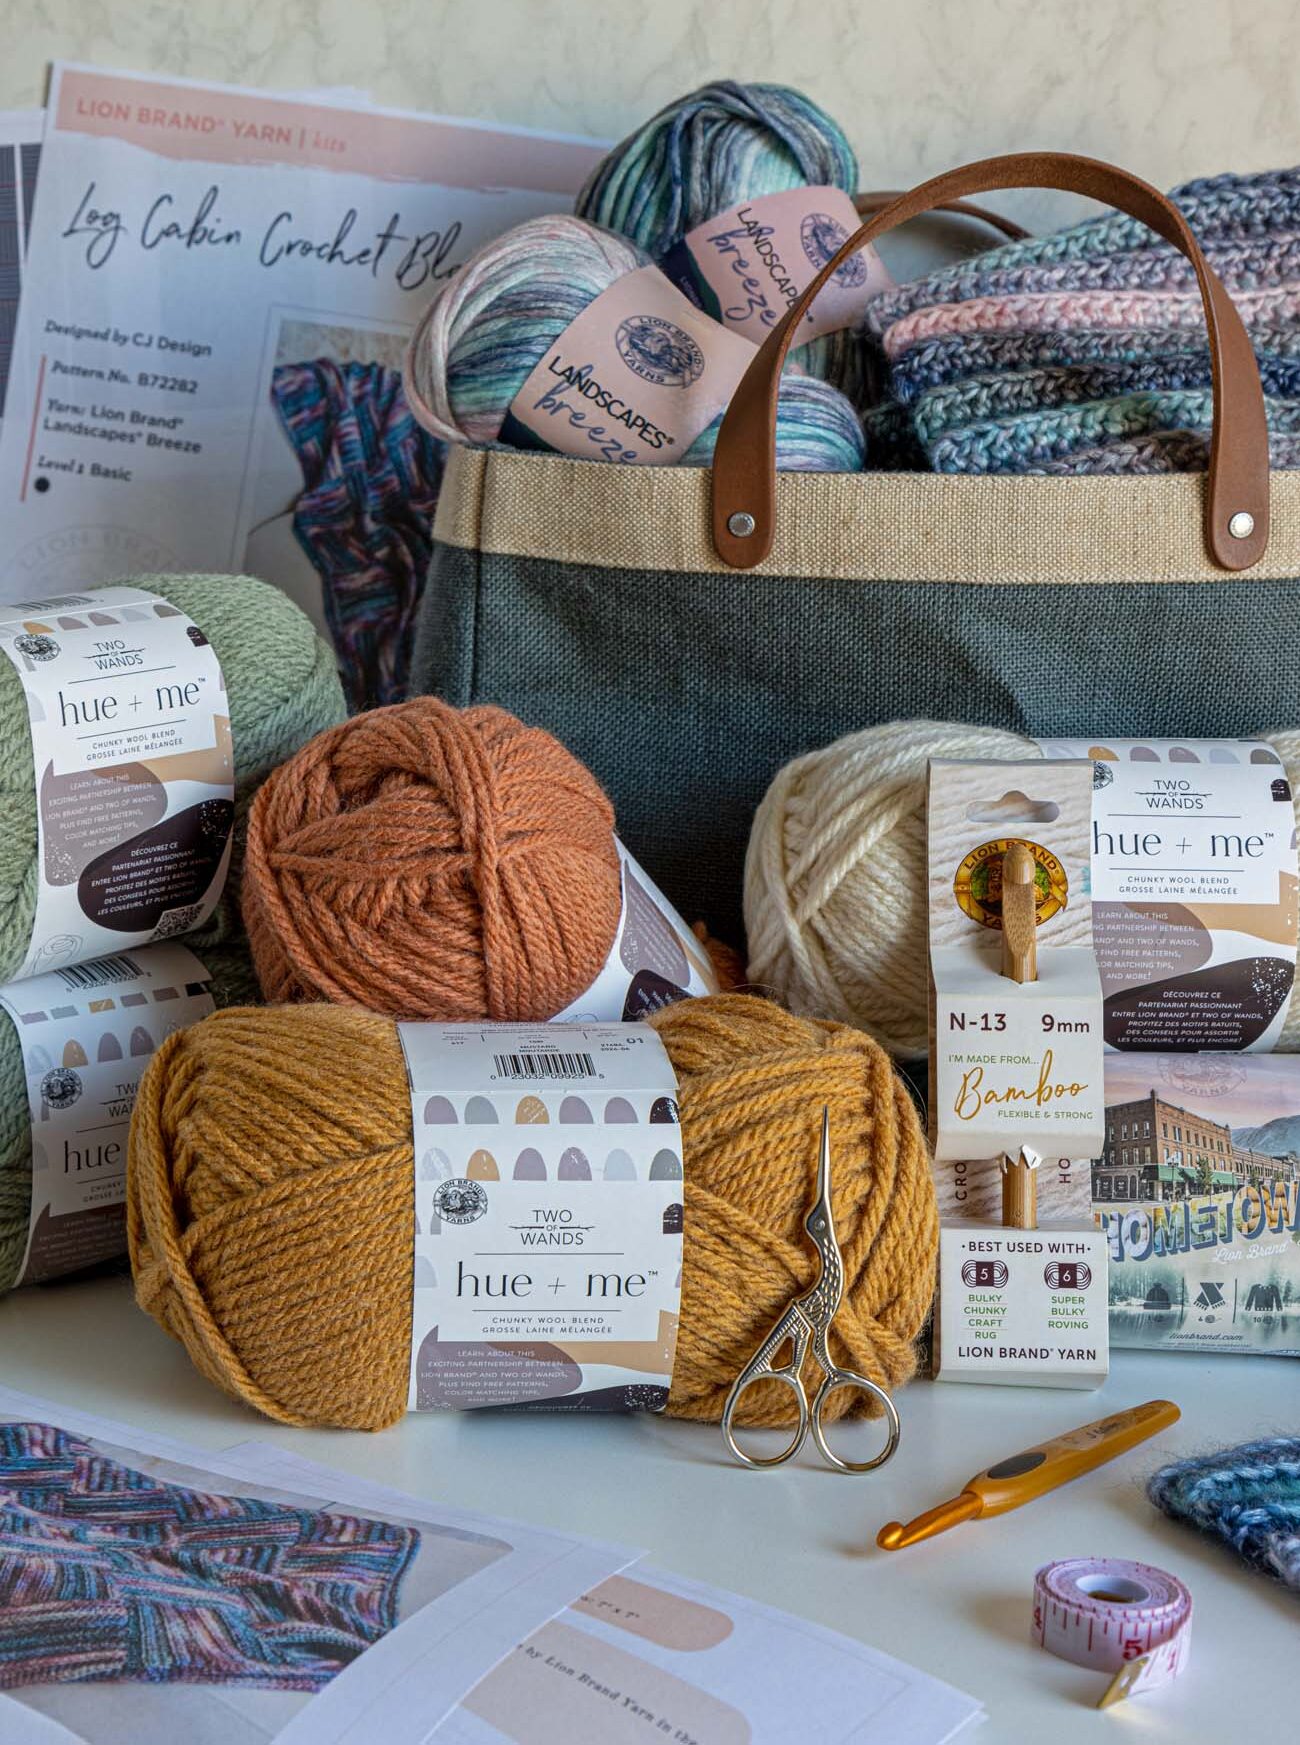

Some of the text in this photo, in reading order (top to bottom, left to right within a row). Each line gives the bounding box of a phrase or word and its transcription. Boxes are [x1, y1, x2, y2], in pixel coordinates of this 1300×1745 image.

[76, 98, 131, 121] LION
[233, 121, 292, 145] YARN
[63, 183, 127, 269] Log
[141, 186, 241, 250] Cabin
[260, 210, 408, 280] Crochet
[737, 207, 810, 316] LANDSCAPE
[707, 226, 777, 327] breeze
[45, 320, 212, 357] Designed by CJ Design
[623, 349, 665, 382] YARNS
[51, 361, 198, 395] Pattern No. B72282
[47, 398, 85, 416] Yarn:
[90, 404, 125, 423] Lion
[146, 433, 202, 454] Breeze
[38, 455, 132, 482] Level 1 Basic
[94, 639, 126, 653] TWO
[95, 654, 144, 670] WANDS
[58, 691, 118, 727] hue
[92, 729, 176, 750] CHUNKY WOOL BLEND
[86, 750, 116, 761] GROSSE
[119, 746, 141, 756] LAINE
[1153, 779, 1191, 791] TWO
[1146, 797, 1204, 810] WANDS
[1093, 821, 1162, 856] hue
[965, 841, 1057, 871] LION BAND
[91, 874, 128, 887] ENTRE LION
[1127, 876, 1230, 885] CHUNKY WOOL BLEND
[1159, 886, 1184, 894] LAINE
[1190, 885, 1238, 895] MÉLANGÉE
[1097, 912, 1169, 920] LEARN ABOUT THIS
[1163, 991, 1208, 999] DÉCOUVREZ
[1138, 1001, 1187, 1009] PARTENARIAT
[950, 1012, 1090, 1033] N-13 9mm
[949, 1055, 963, 1064] I'M
[967, 1055, 997, 1064] MADE
[511, 1073, 545, 1081] 23032
[954, 1049, 1089, 1120] Bamboo
[998, 1109, 1093, 1119] FLEXIBLE & STRONG
[64, 1140, 121, 1173] hue
[438, 1179, 483, 1195] LION BRAND
[447, 1215, 475, 1223] YARNS
[532, 1209, 572, 1223] TWO
[546, 1224, 557, 1232] OF
[520, 1232, 584, 1245] WANDS
[968, 1241, 1085, 1254] BEST USED WITH
[456, 1261, 533, 1297] hue
[980, 1268, 988, 1281] 5
[1062, 1269, 1071, 1283] 6
[968, 1294, 1002, 1303] BULKY
[1051, 1295, 1085, 1304] SUPER
[964, 1305, 1007, 1315] CHUNKY
[1051, 1307, 1085, 1317] BULKY
[482, 1325, 612, 1334] GROSSE LAINE MÉLANGÉE
[968, 1318, 1003, 1328] CRAFT
[1048, 1320, 1089, 1330] ROVING
[974, 1331, 997, 1340] RUG
[1169, 1332, 1244, 1342] lionbrand.com
[958, 1346, 994, 1358] LION
[1057, 1348, 1096, 1361] YARN
[1122, 1639, 1144, 1660] 5
[525, 1646, 543, 1660] by
[545, 1655, 575, 1677] Lion
[577, 1672, 621, 1702] Brand
[622, 1697, 654, 1723] Yarn
[656, 1717, 673, 1733] in
